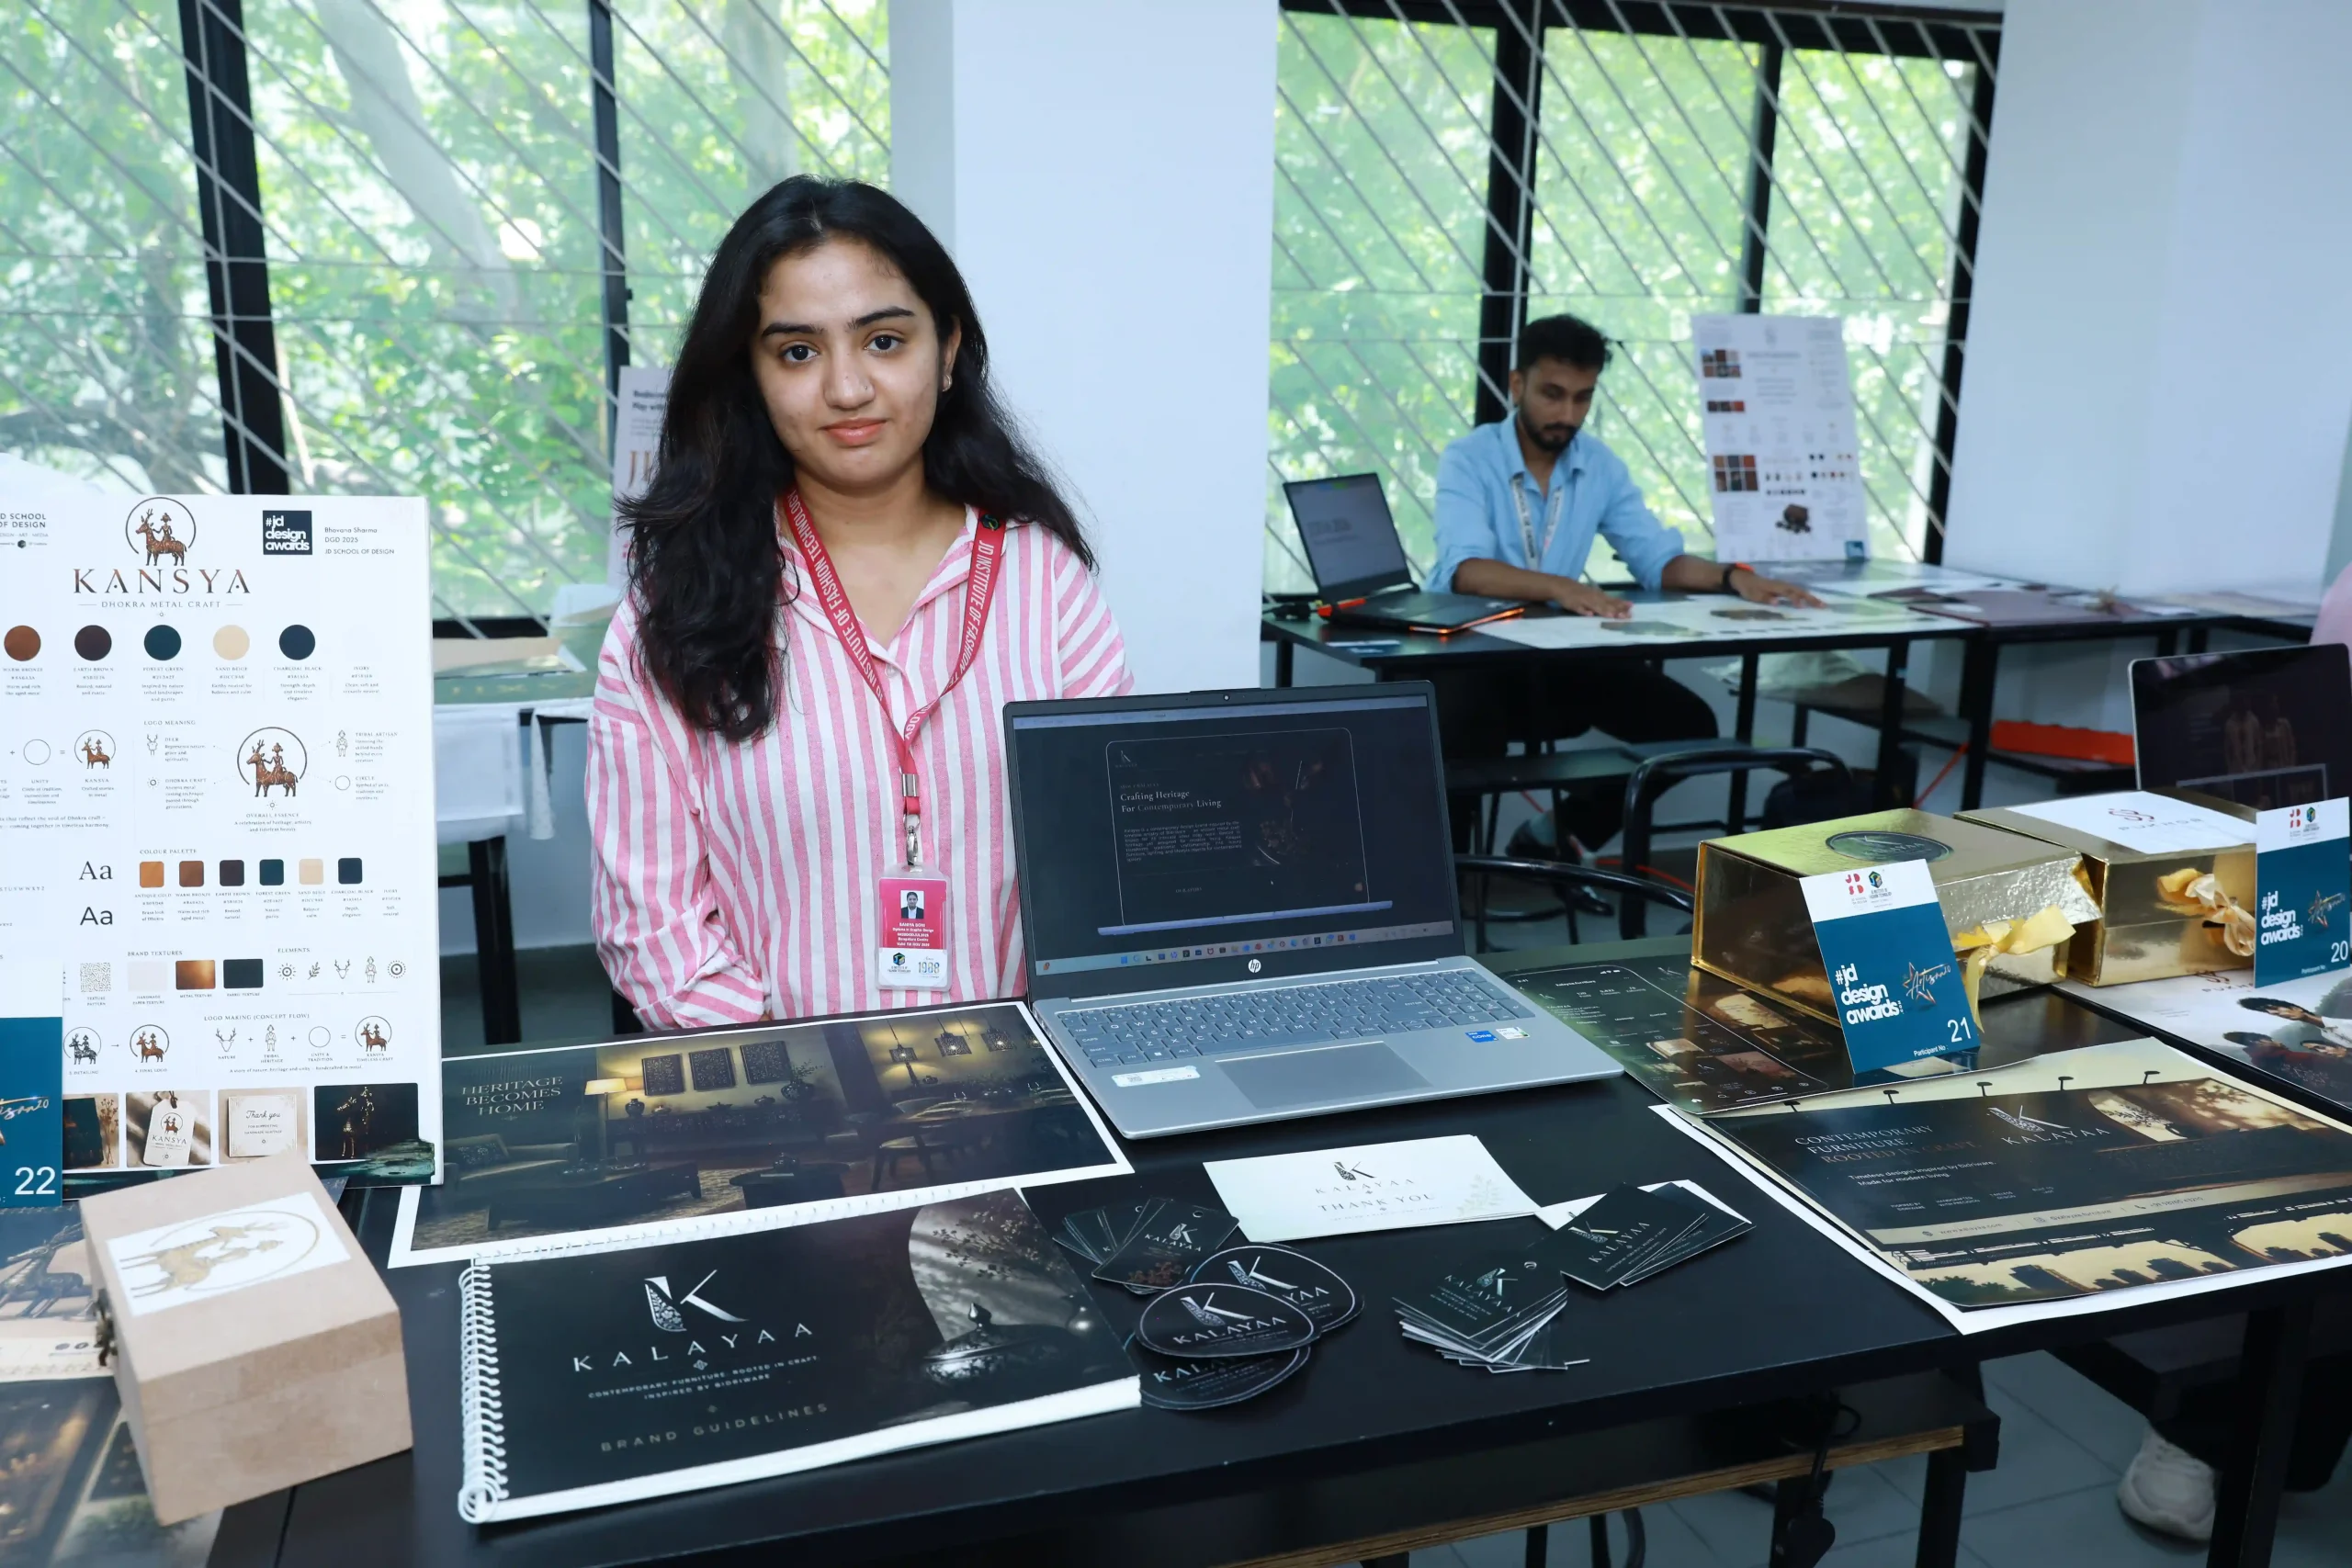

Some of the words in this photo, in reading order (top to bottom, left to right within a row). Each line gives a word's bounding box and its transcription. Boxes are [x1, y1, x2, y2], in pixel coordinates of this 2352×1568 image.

[266, 528, 307, 543] design
[786, 490, 821, 565] TECHNOLOGY
[266, 540, 310, 551] awards
[979, 540, 994, 556] JD
[74, 569, 252, 594] KANSYA
[814, 558, 843, 611] FASHION
[971, 555, 992, 609] INSTITUTE
[833, 606, 850, 625] OF
[968, 606, 982, 622] OF
[842, 623, 877, 688] INSTITUTE
[959, 619, 978, 677] FASHION
[1120, 792, 1154, 802] Crafting
[1156, 791, 1190, 800] Heritage
[1122, 805, 1136, 813] For
[1137, 802, 1194, 812] Contemporary
[1196, 799, 1222, 808] Living
[79, 861, 113, 881] Aa
[80, 907, 113, 926] Aa
[2261, 909, 2296, 929] design
[2261, 924, 2301, 945] awards
[2331, 941, 2348, 964] 20
[1250, 961, 1261, 973] hp
[1840, 984, 1889, 1006] design
[1846, 998, 1900, 1025] awards
[1948, 1017, 1972, 1043] 21
[1913, 1046, 1938, 1057] Participant
[461, 1077, 563, 1095] HERITAGE
[466, 1088, 561, 1106] BECOMES
[246, 1111, 266, 1119] Thank
[266, 1111, 281, 1120] you
[478, 1100, 545, 1116] HOME
[153, 1135, 187, 1145] KANSYA
[1795, 1125, 1934, 1145] CONTEMPORARY
[2002, 1127, 2111, 1146] KALAYAA
[1807, 1138, 1913, 1155] FURNITURE.
[1821, 1150, 1896, 1164] ROOTED
[1915, 1166, 1946, 1174] inspired
[15, 1167, 56, 1195] 22
[1316, 1179, 1415, 1194] KALAYAA
[1317, 1199, 1387, 1212] THANK
[1395, 1193, 1436, 1203] YOU
[1145, 1234, 1202, 1252] KALAYAA
[1589, 1223, 1650, 1263] KALAYAA
[1173, 1317, 1286, 1345] KALAYAA
[572, 1323, 812, 1372] KALAYAA
[588, 1382, 668, 1399] CONTEMPORARY
[732, 1364, 771, 1375] ROOTED
[644, 1387, 693, 1400] INSPIRED
[715, 1374, 771, 1388] BIDRIWARE
[601, 1431, 677, 1452] BRAND
[693, 1403, 828, 1436] GUIDELINES
